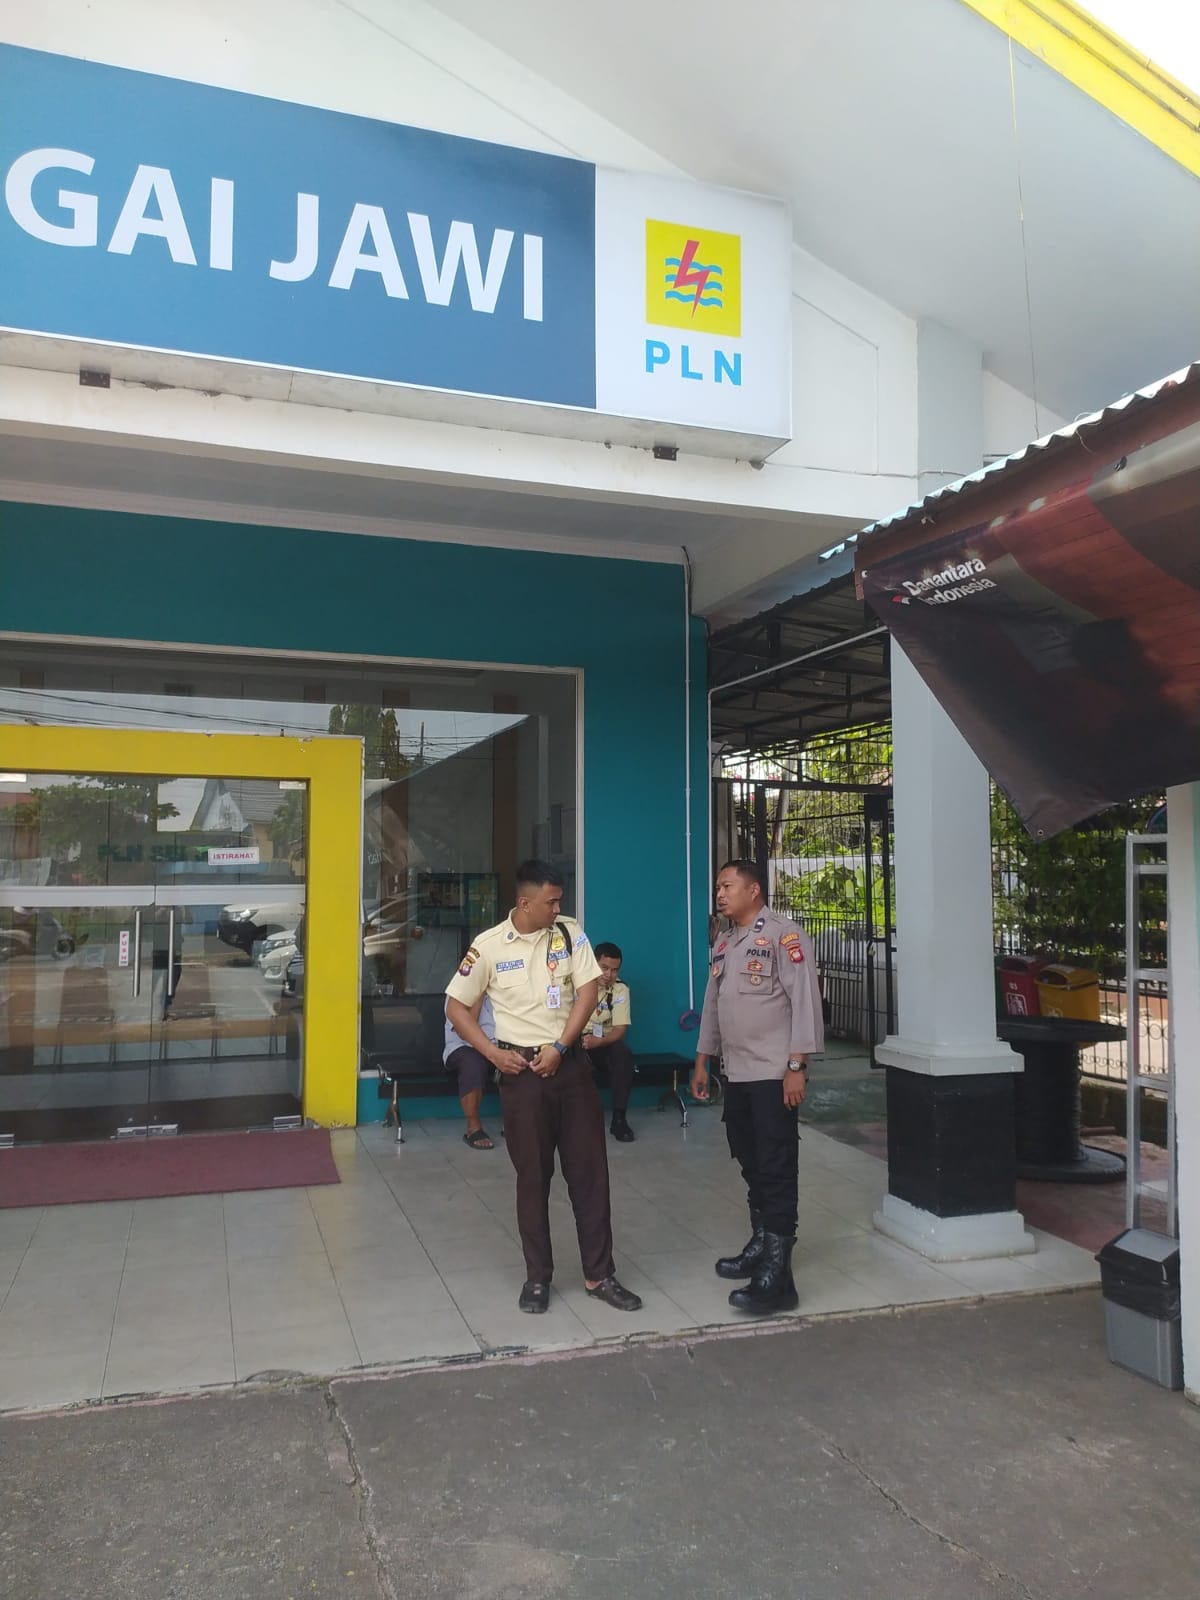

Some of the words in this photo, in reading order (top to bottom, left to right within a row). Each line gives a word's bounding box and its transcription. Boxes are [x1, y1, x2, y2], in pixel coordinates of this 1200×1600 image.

[4, 147, 234, 271] GAI
[268, 192, 544, 323] JAWI
[645, 338, 742, 386] PLN
[902, 558, 986, 595] Danantara
[213, 852, 255, 861] ISTIRAHAT
[746, 949, 770, 958] POLRI
